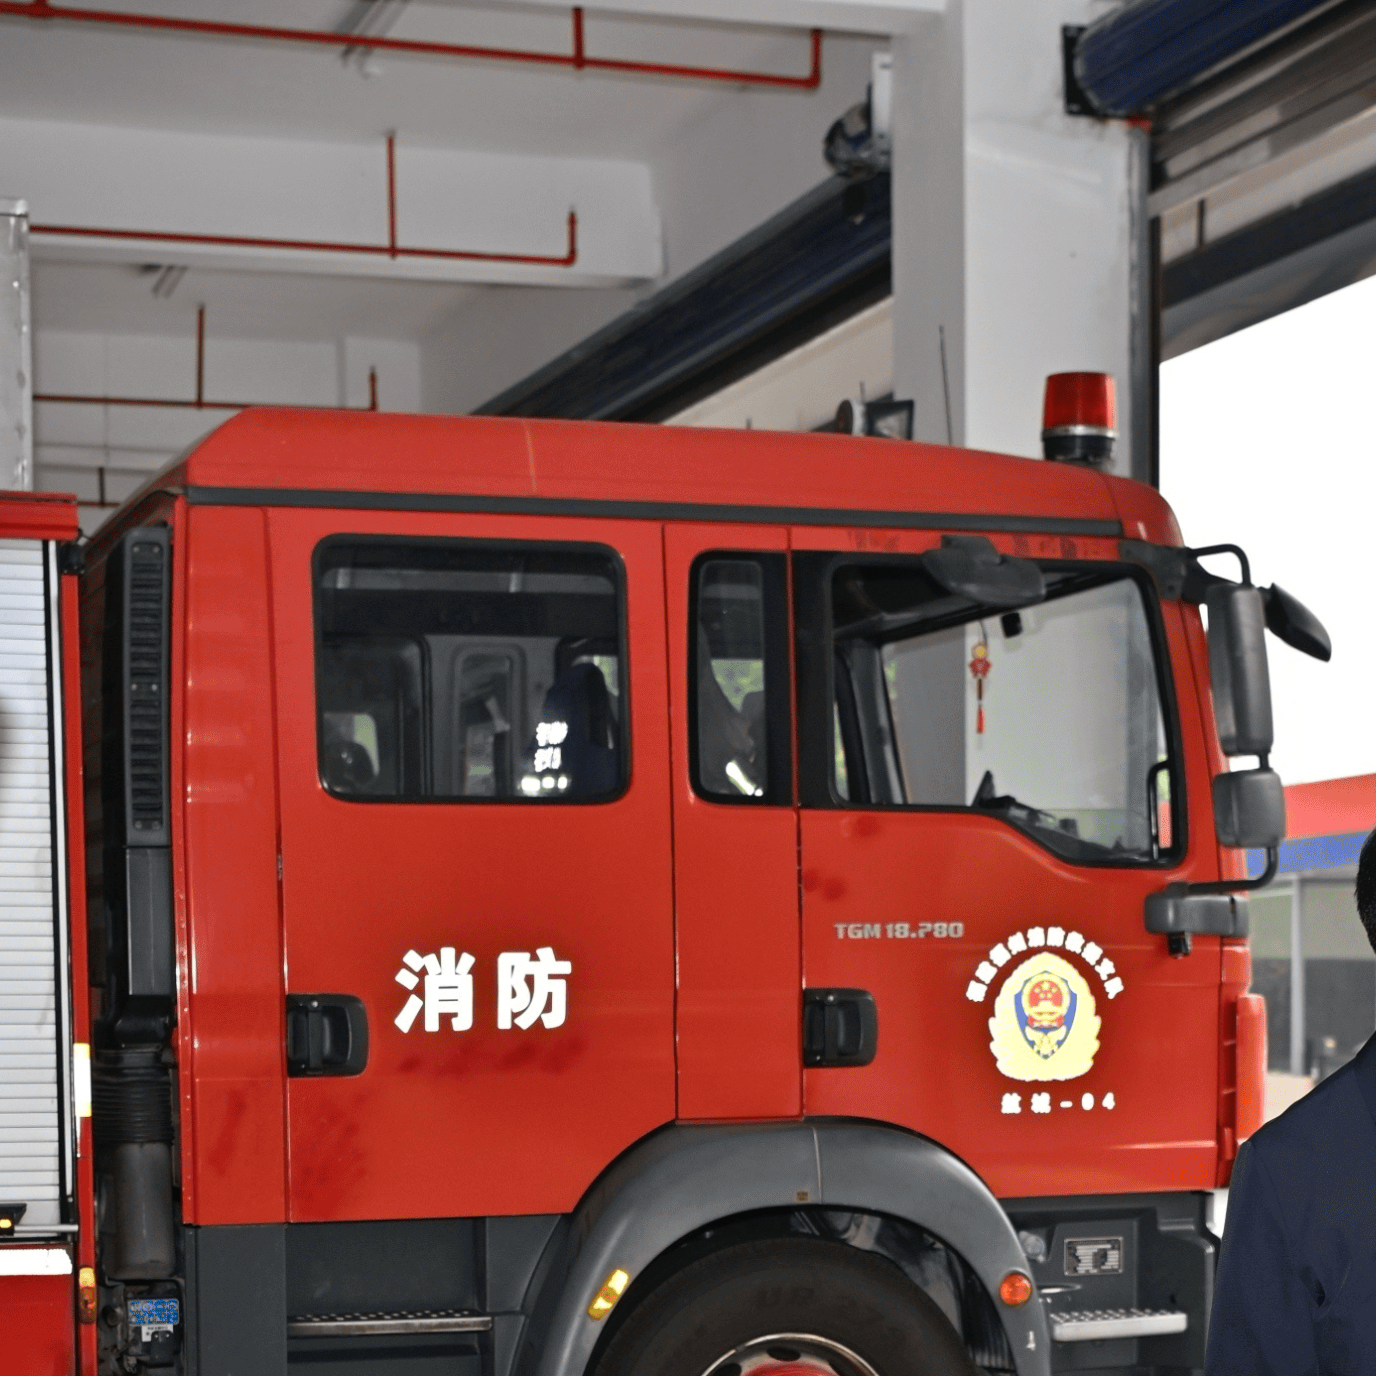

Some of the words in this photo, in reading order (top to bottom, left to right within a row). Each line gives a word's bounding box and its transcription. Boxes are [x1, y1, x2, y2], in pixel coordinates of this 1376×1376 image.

[834, 921, 881, 940] TGM
[885, 920, 965, 939] 18.280
[394, 946, 573, 1034] 消防
